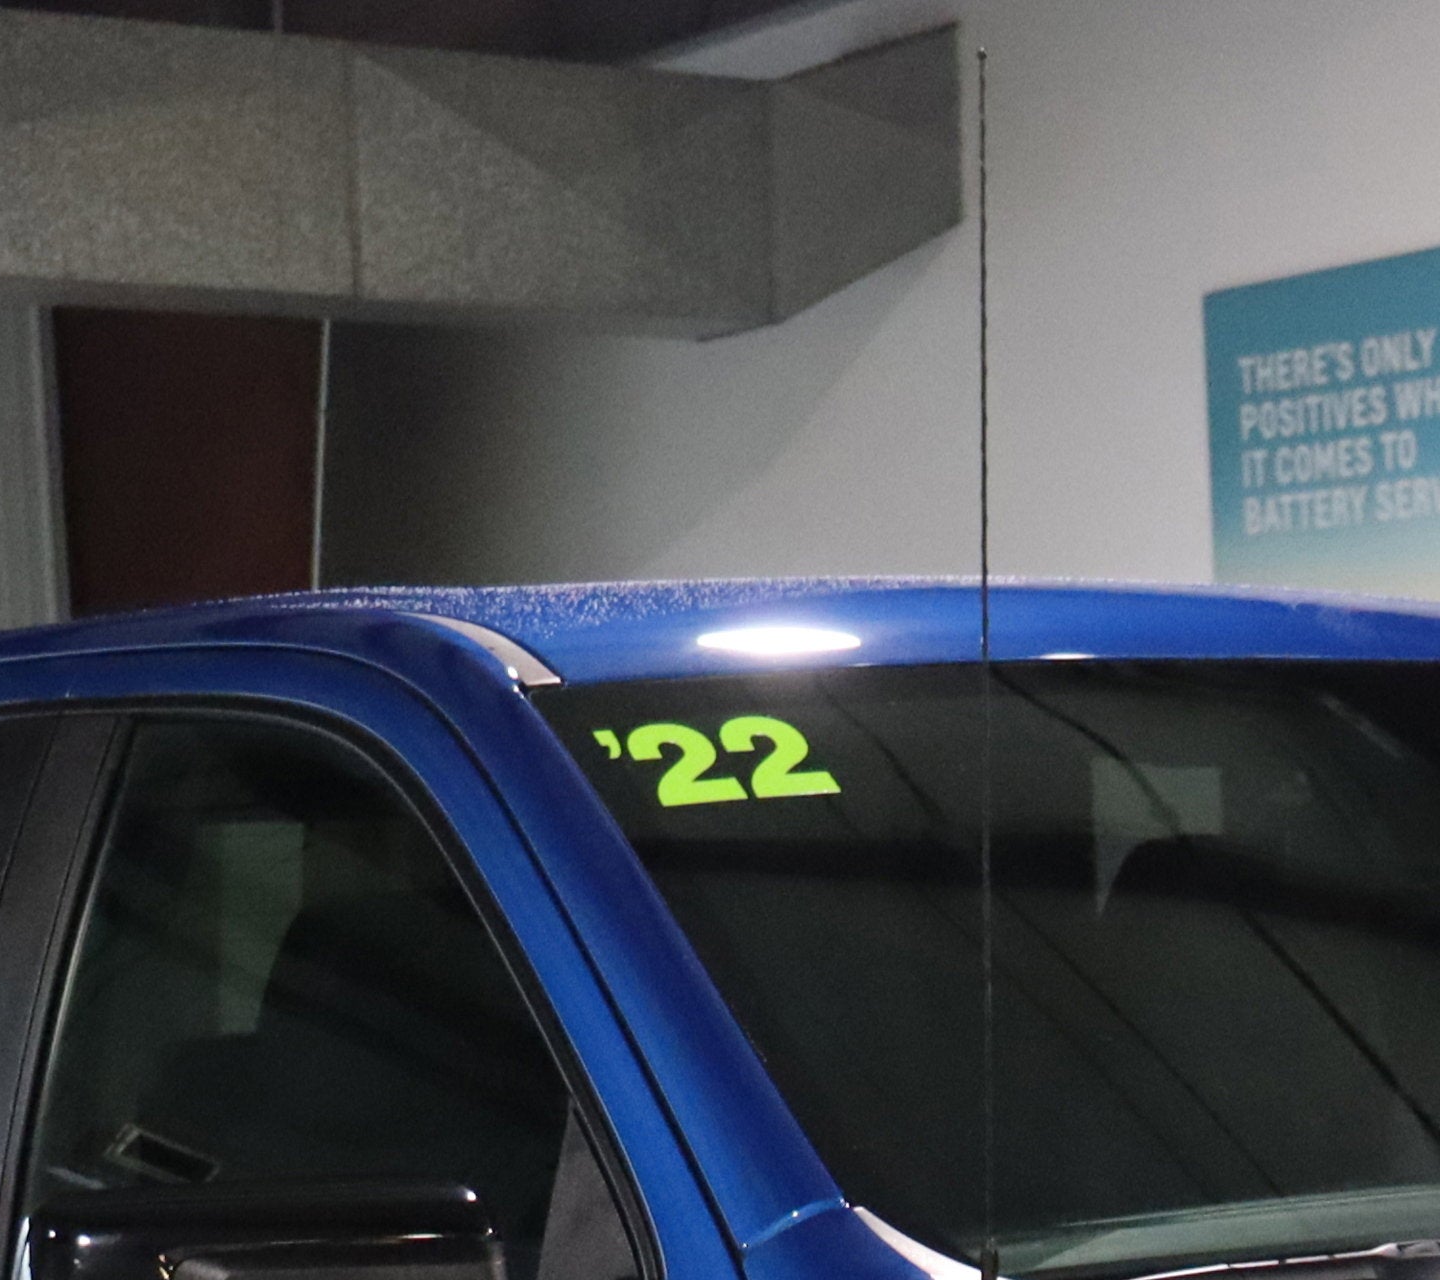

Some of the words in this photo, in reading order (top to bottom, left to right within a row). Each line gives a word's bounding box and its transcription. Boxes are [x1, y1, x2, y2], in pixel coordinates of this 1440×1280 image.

[1238, 342, 1355, 395] THERE'S
[1361, 327, 1437, 377] ONLY
[1239, 386, 1388, 441] POSITIVES
[1241, 448, 1267, 488] IT
[1275, 437, 1374, 486] COMES
[1379, 429, 1418, 471] TO
[1242, 484, 1369, 536] BATTERY
[593, 715, 841, 807] '22
